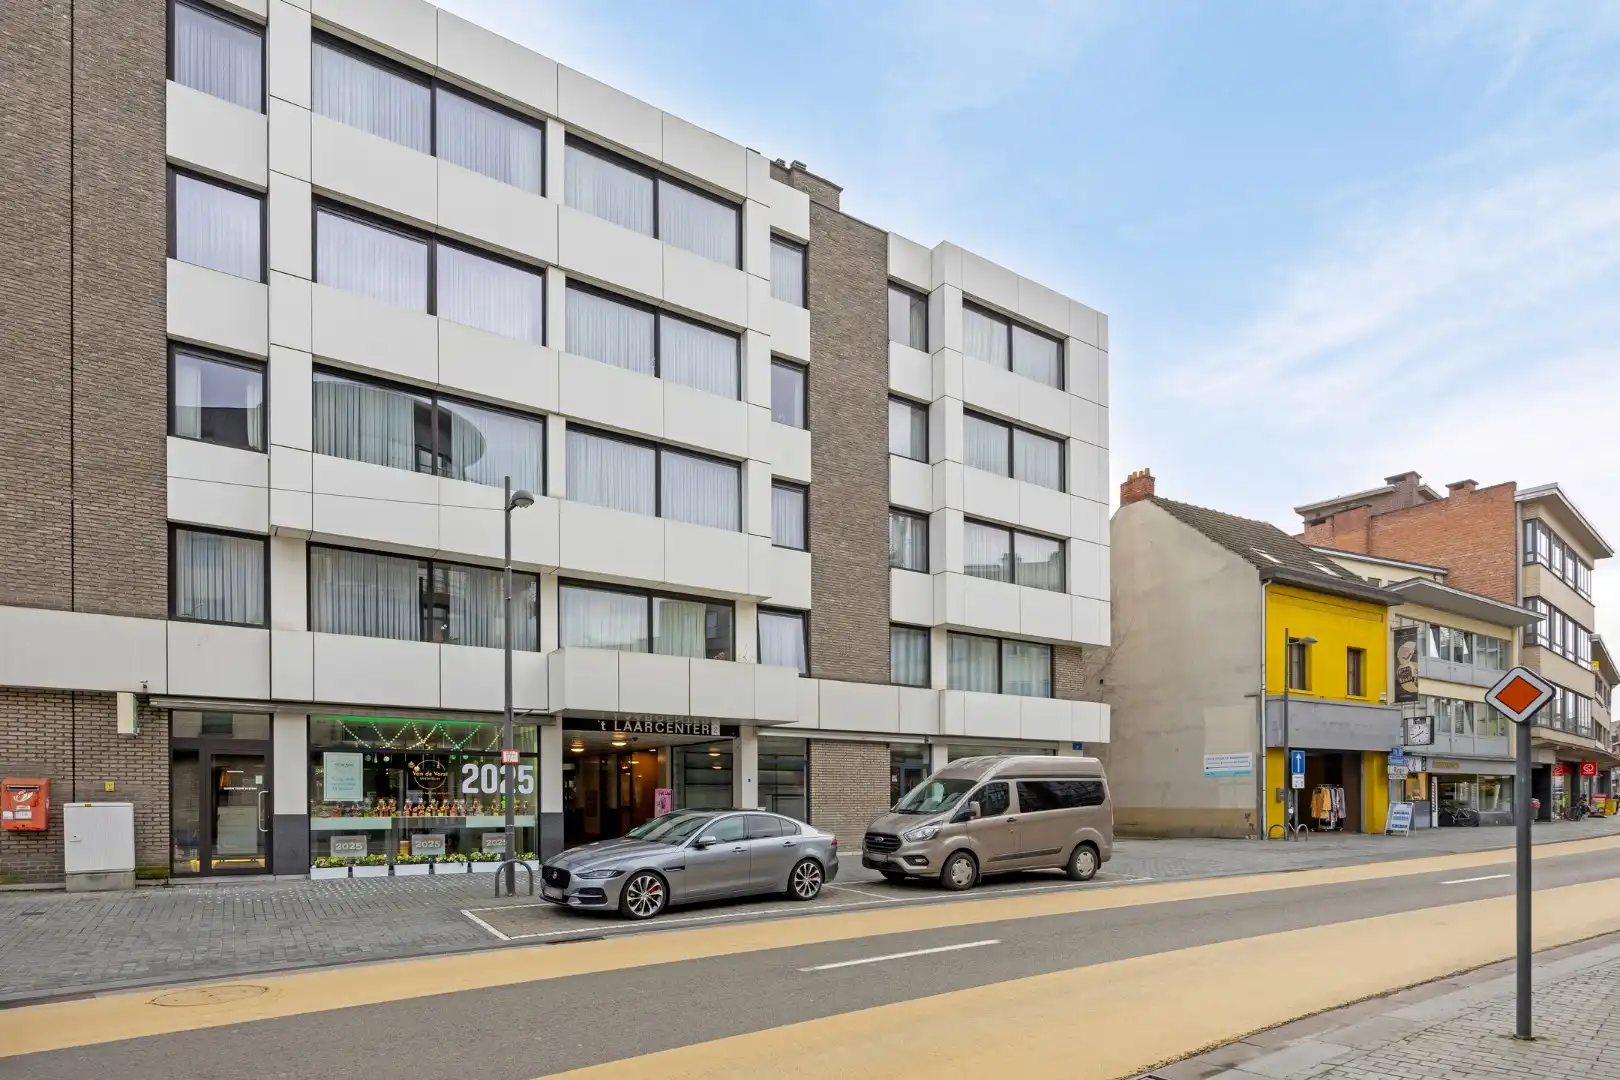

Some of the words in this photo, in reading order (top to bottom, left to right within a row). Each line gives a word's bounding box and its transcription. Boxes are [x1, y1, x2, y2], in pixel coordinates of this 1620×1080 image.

[614, 720, 710, 734] LAARCENTER
[335, 842, 363, 851] 2025
[415, 840, 441, 848] 2025
